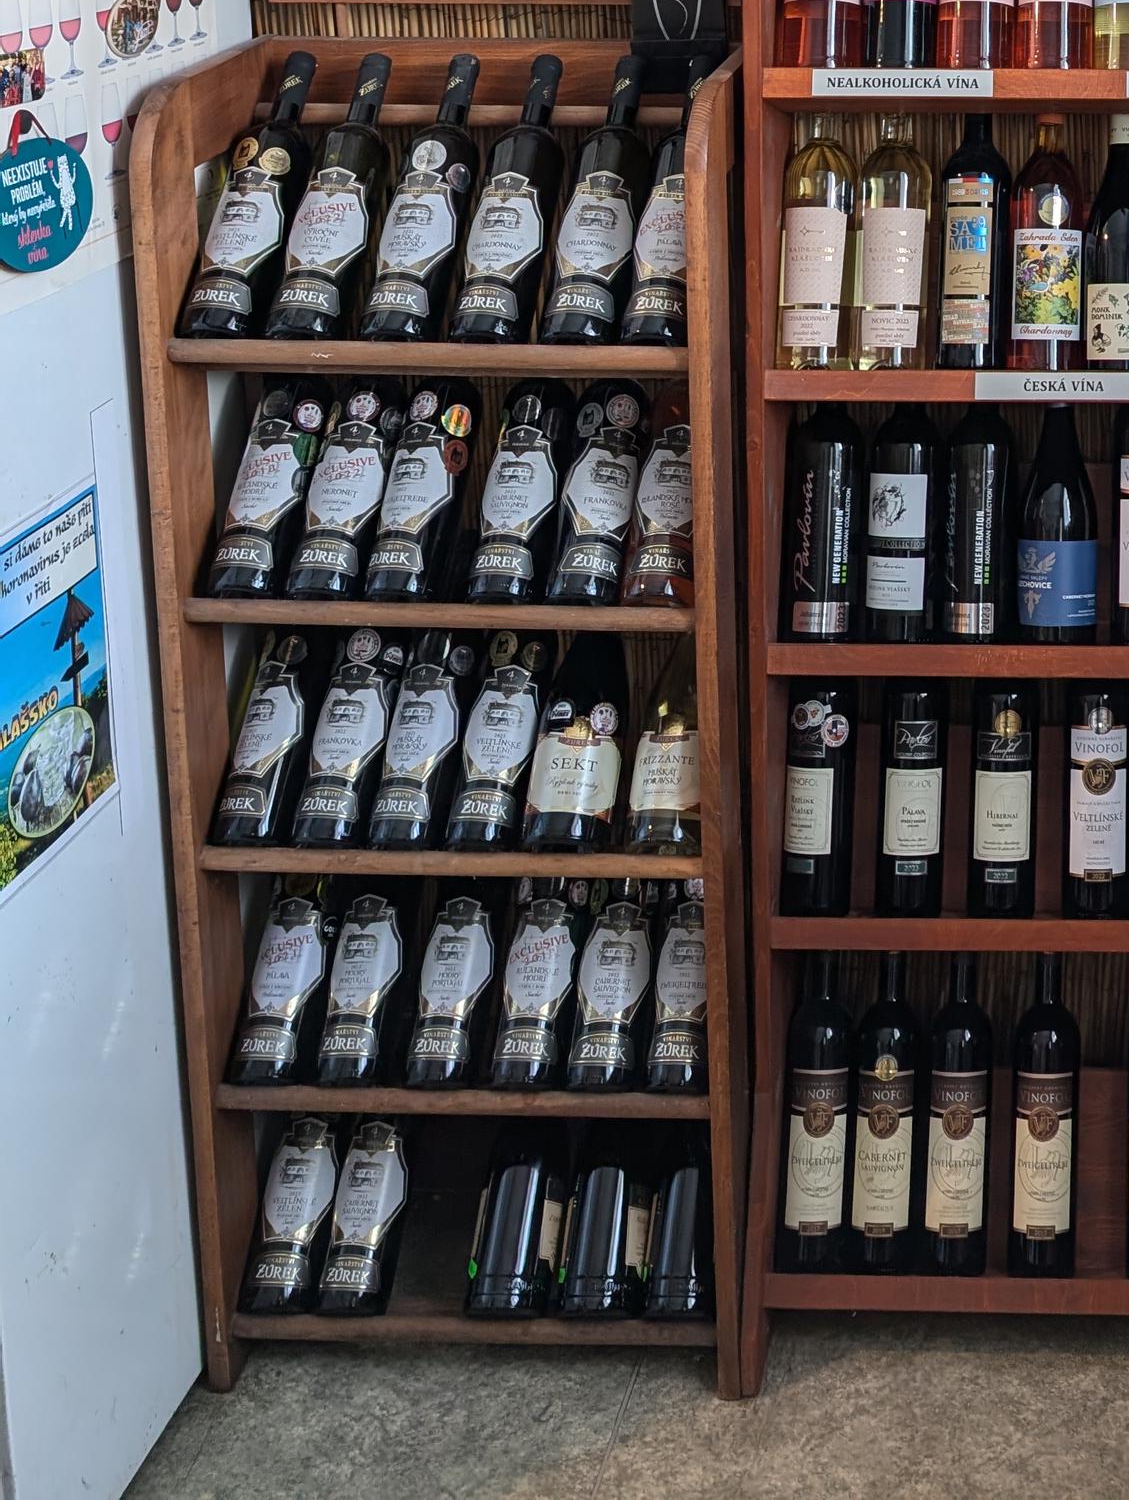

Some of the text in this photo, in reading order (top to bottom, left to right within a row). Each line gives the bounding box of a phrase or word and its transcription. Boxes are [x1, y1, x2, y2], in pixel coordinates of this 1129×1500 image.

[827, 74, 979, 89] NEALKOHOLICKÁ VÍNA
[1, 157, 48, 187] NEEXISTUJE
[1019, 232, 1056, 242] Zahrada
[472, 239, 522, 251] CHARDONNAY
[566, 240, 617, 251] CHARDONNAY
[1020, 325, 1073, 337] Chardonnay
[1024, 377, 1104, 392] ČESKÁ VÍNA
[844, 486, 852, 527] COLLECTION
[4, 554, 12, 572] si
[42, 530, 53, 546] to
[837, 605, 845, 630] 2023
[1075, 742, 1124, 755] VINOFOL
[551, 757, 599, 772] SEKT
[639, 755, 695, 766] FRIZZANTE
[1073, 811, 1123, 822] VELTLÍNSKÉ
[1086, 824, 1111, 832] ZELENÉ
